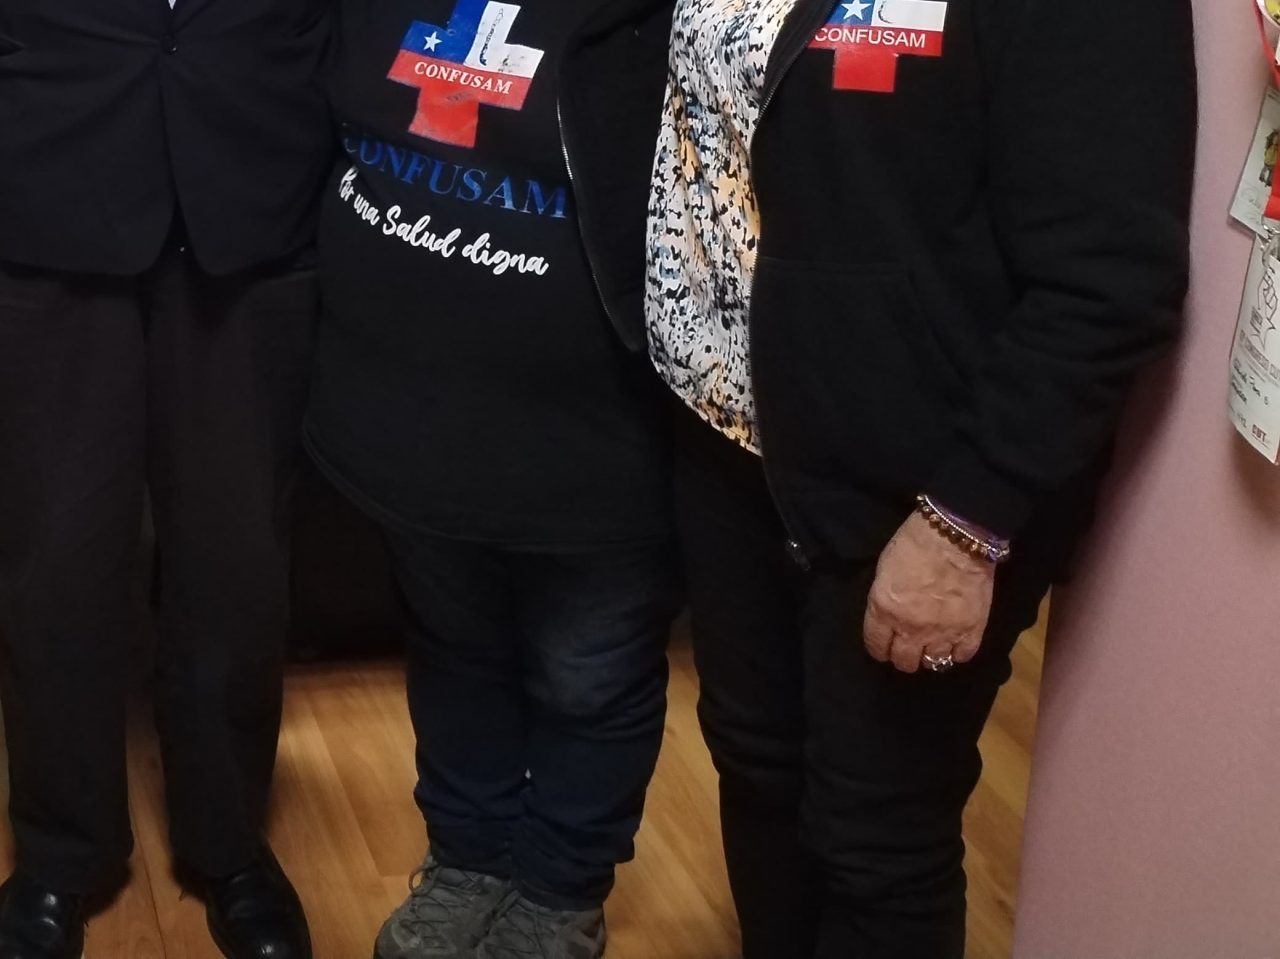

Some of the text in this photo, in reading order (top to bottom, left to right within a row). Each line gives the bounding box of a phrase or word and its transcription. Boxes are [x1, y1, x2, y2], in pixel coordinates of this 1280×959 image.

[815, 27, 926, 48] CONFUSAM
[414, 61, 513, 94] CONFUSAM
[338, 165, 550, 275] Por una Salud digna
